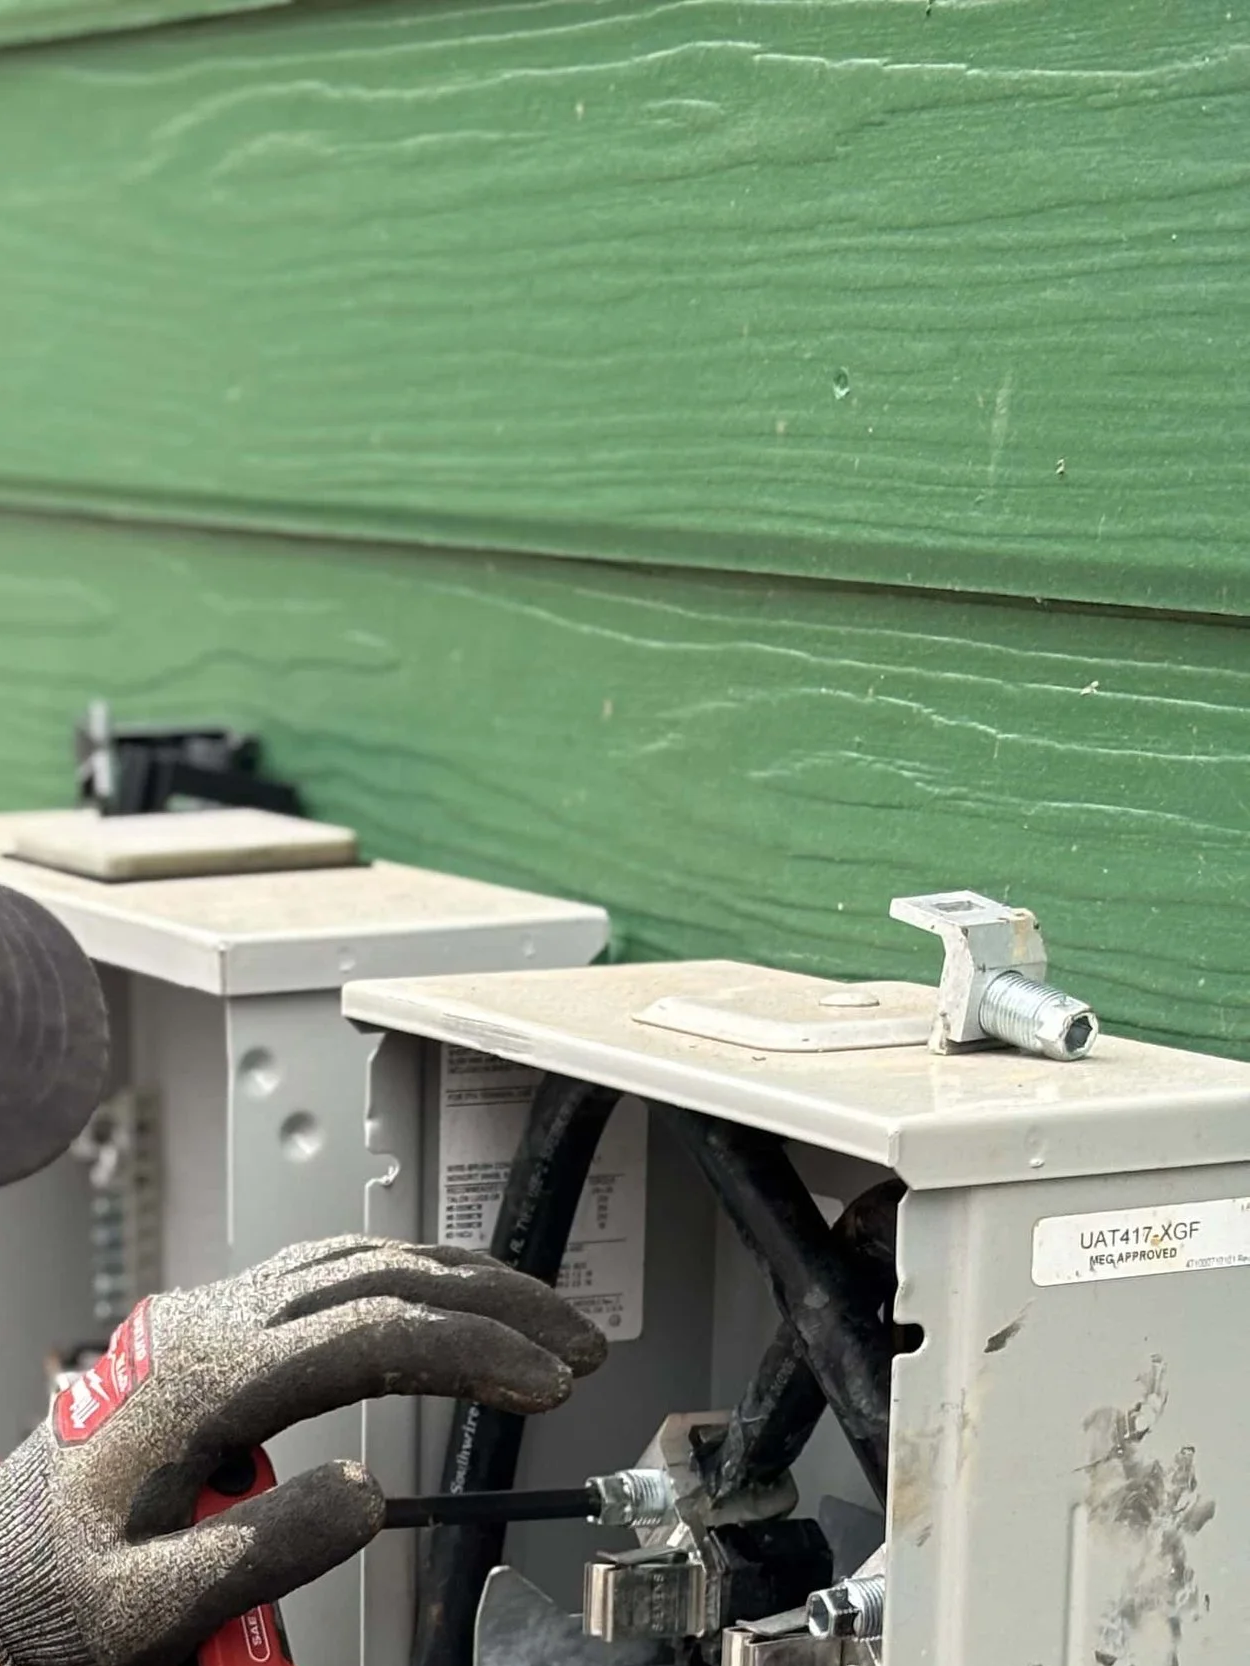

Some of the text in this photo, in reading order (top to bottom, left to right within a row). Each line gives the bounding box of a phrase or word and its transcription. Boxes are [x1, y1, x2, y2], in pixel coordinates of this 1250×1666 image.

[1080, 1221, 1201, 1249] UAT417-XGF
[1090, 1248, 1177, 1267] MEG APPROVED
[450, 1406, 481, 1495] Southwire
[248, 1615, 262, 1647] SAE
